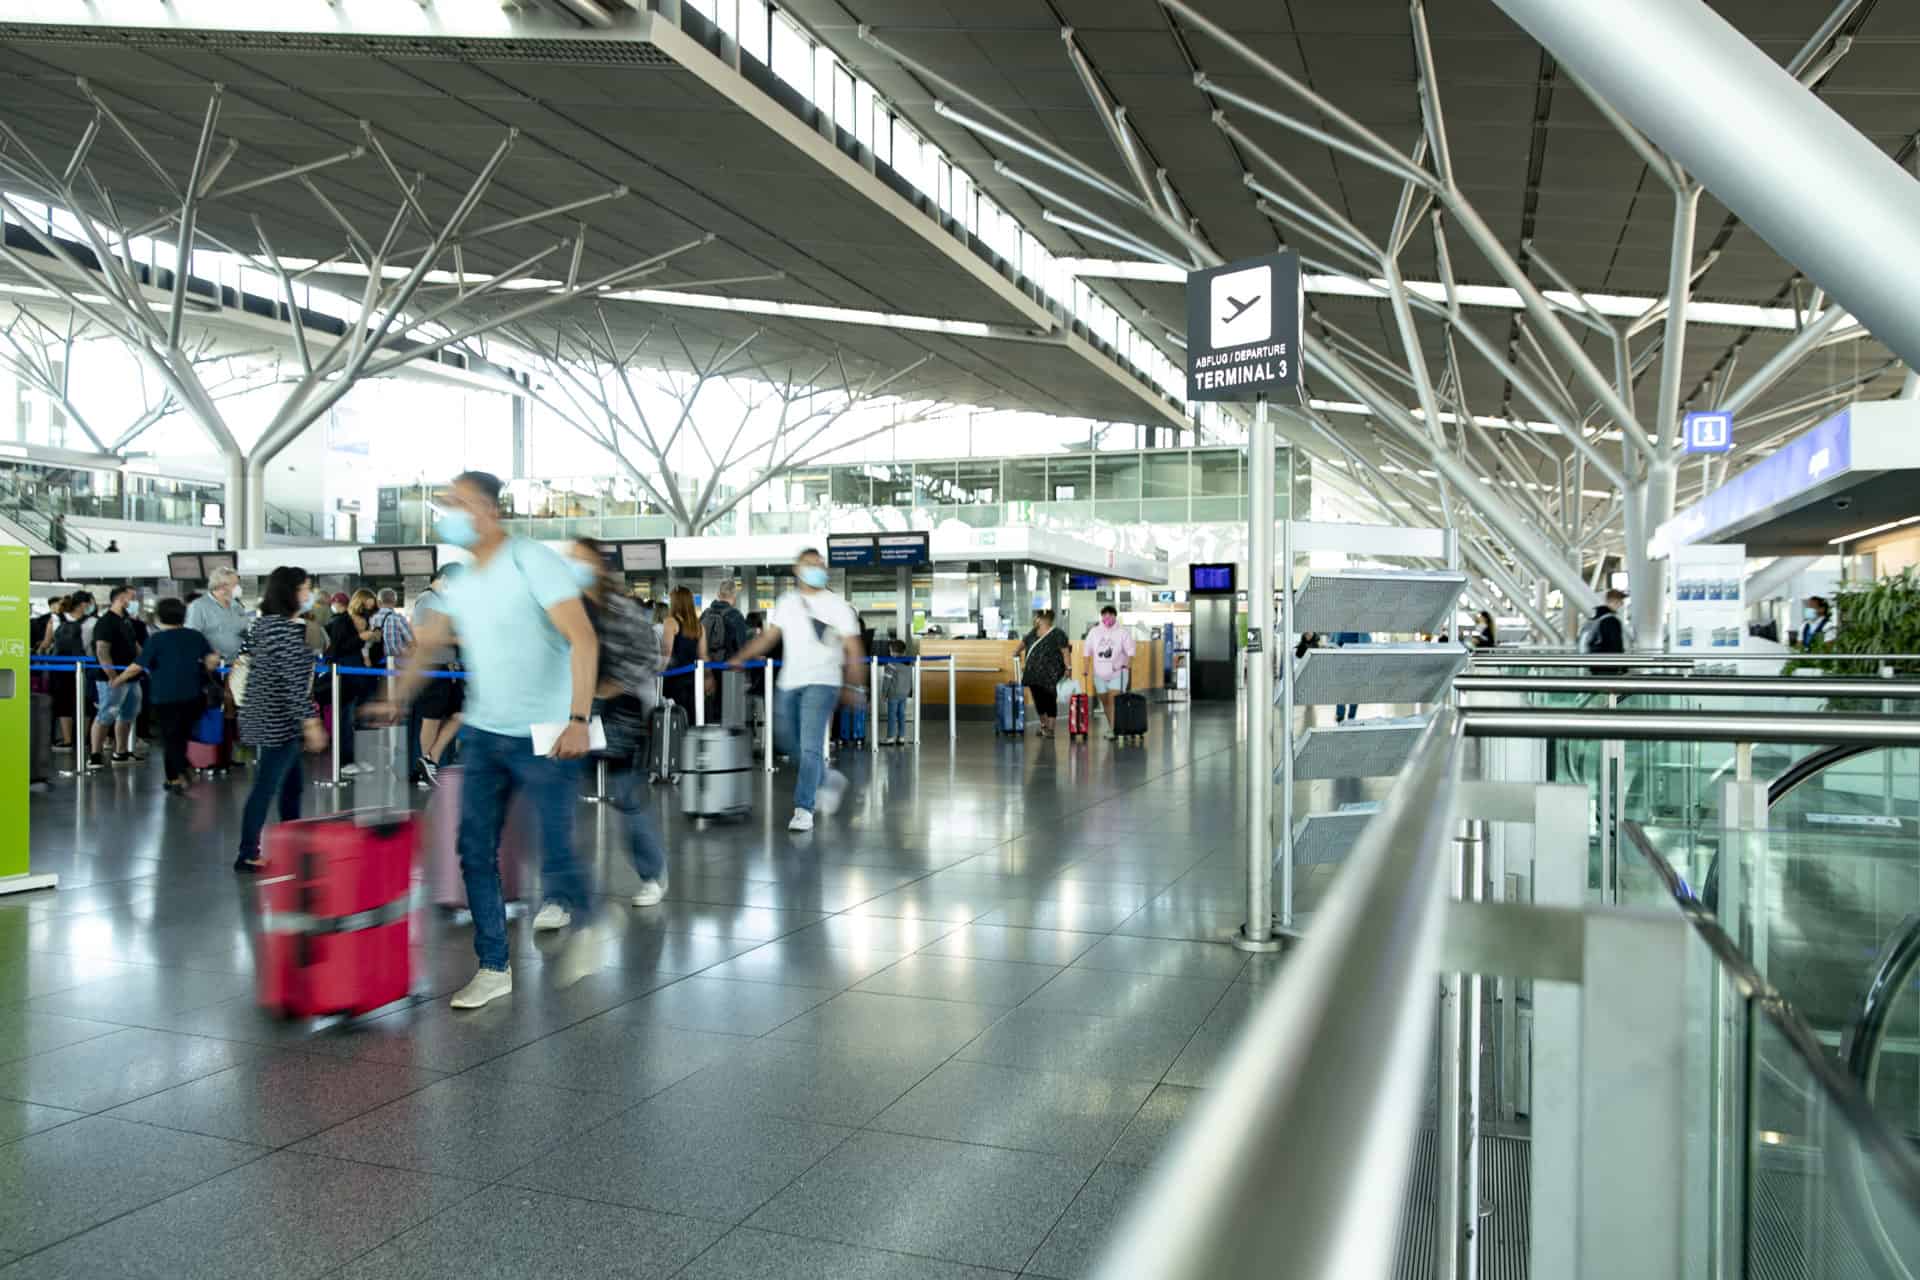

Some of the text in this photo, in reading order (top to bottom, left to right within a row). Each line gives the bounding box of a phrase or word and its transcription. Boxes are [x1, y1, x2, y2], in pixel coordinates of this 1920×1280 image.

[1196, 353, 1228, 368] ABFLUG
[1234, 343, 1286, 362] DEPARTURE
[1195, 360, 1288, 390] TERMINAL 3
